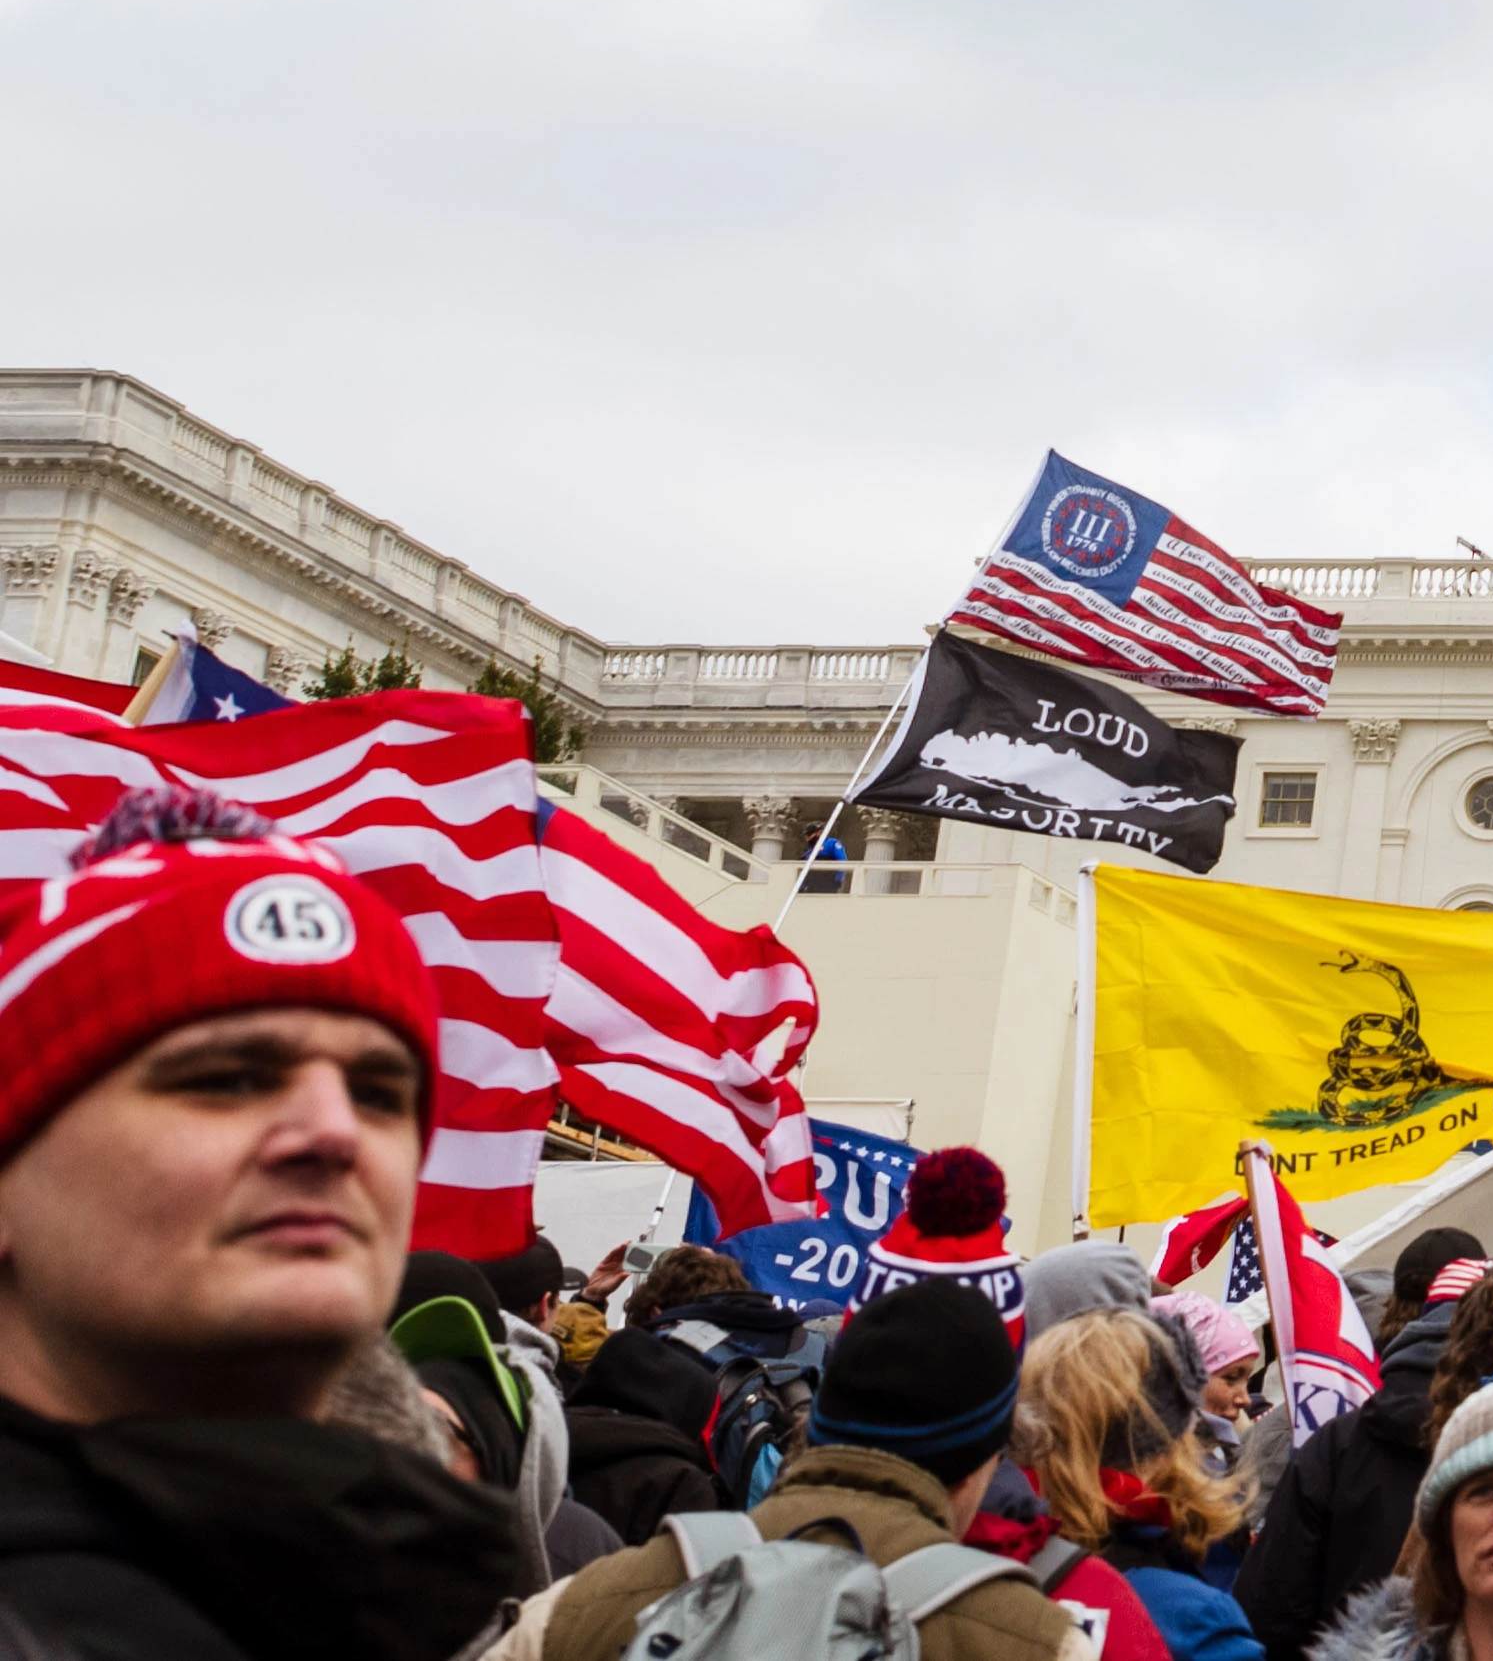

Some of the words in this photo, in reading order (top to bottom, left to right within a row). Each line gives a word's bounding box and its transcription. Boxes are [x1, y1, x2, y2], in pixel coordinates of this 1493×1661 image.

[1066, 534, 1098, 553] 1776
[1069, 507, 1113, 542] III
[1166, 538, 1177, 550] A
[1179, 545, 1205, 563] free
[1205, 559, 1241, 588] people
[1152, 569, 1191, 592] armed
[1193, 588, 1214, 607] and
[1008, 618, 1043, 641] Their
[1072, 584, 1085, 597] to
[1085, 592, 1138, 629] maintain
[1140, 623, 1154, 635] A
[1195, 648, 1208, 664] of
[1141, 594, 1178, 621] should
[1212, 633, 1271, 660] sufficient
[1300, 675, 1323, 694] And
[1123, 643, 1137, 656] to
[1032, 699, 1150, 758] LOUD
[257, 899, 325, 939] 45
[1329, 1124, 1427, 1166] TREAD
[1439, 1102, 1479, 1132] ON
